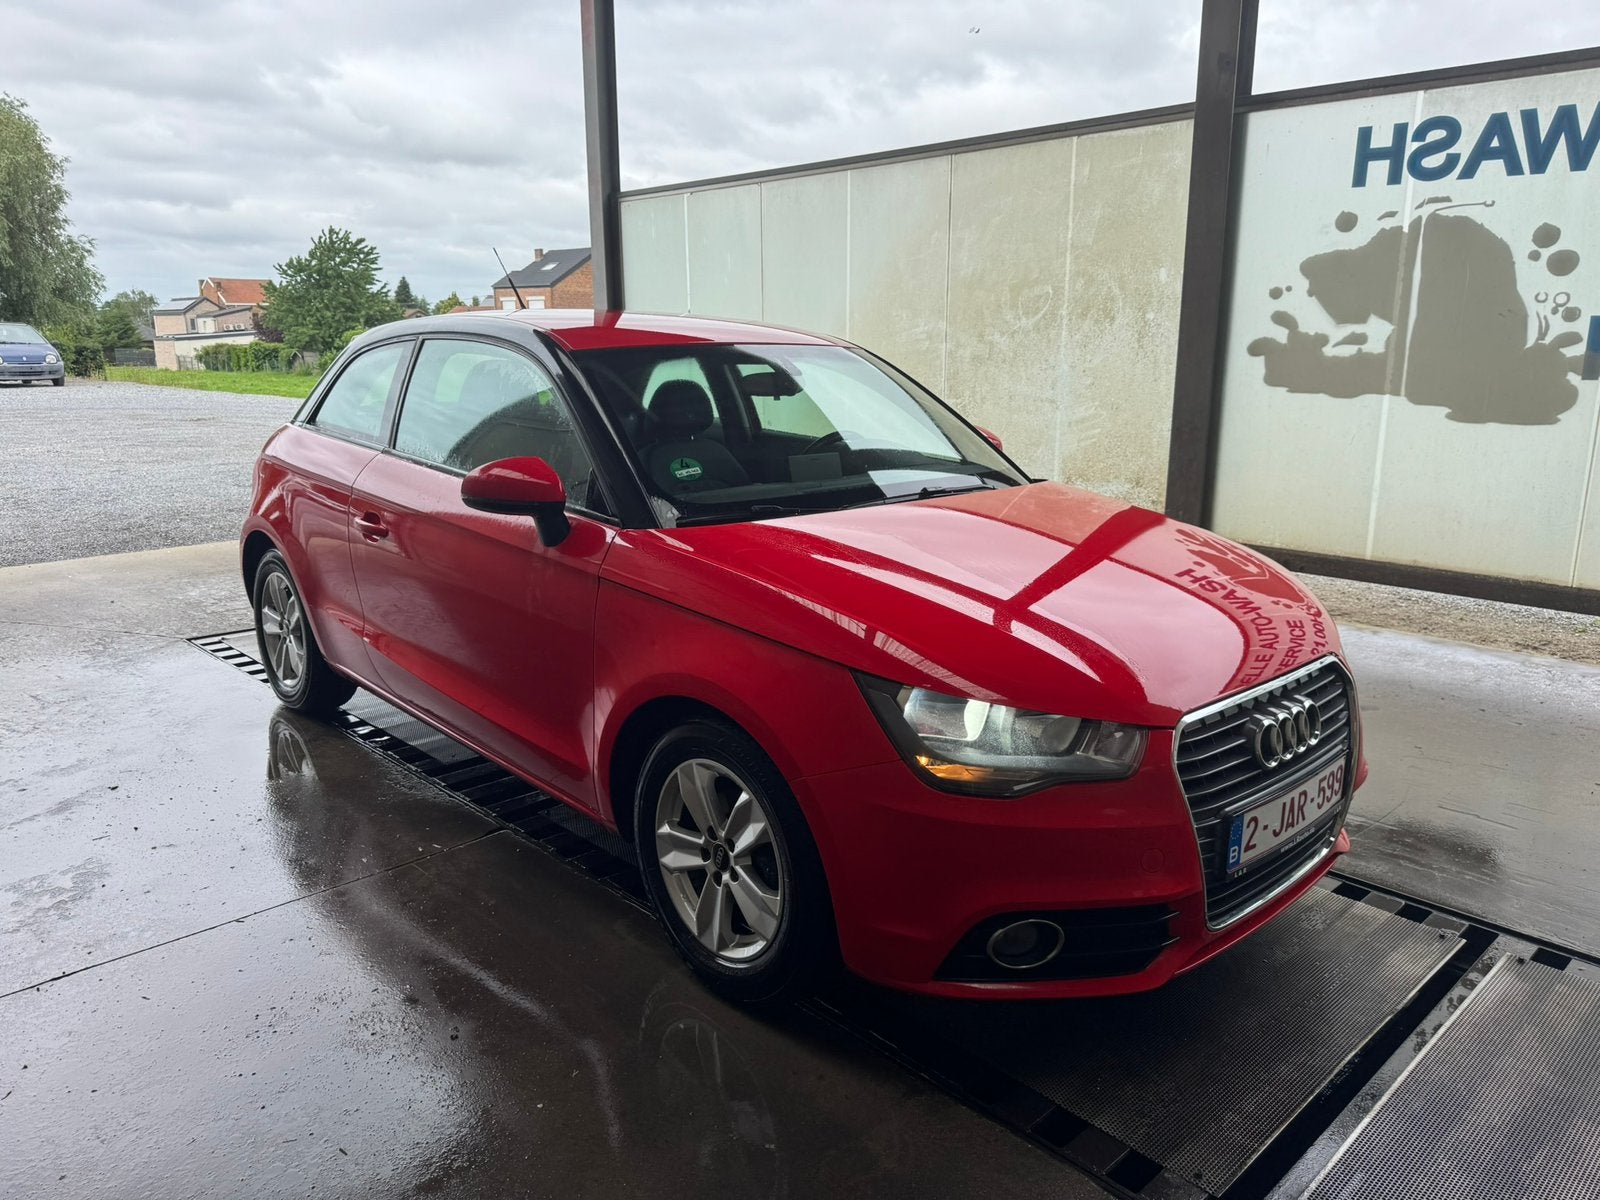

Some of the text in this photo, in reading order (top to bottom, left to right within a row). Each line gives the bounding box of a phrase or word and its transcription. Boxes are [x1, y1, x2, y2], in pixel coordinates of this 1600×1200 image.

[1175, 568, 1280, 688] ELLE AUTO-WASH
[1243, 764, 1343, 853] 2-JAR-599
[1229, 846, 1239, 864] B
